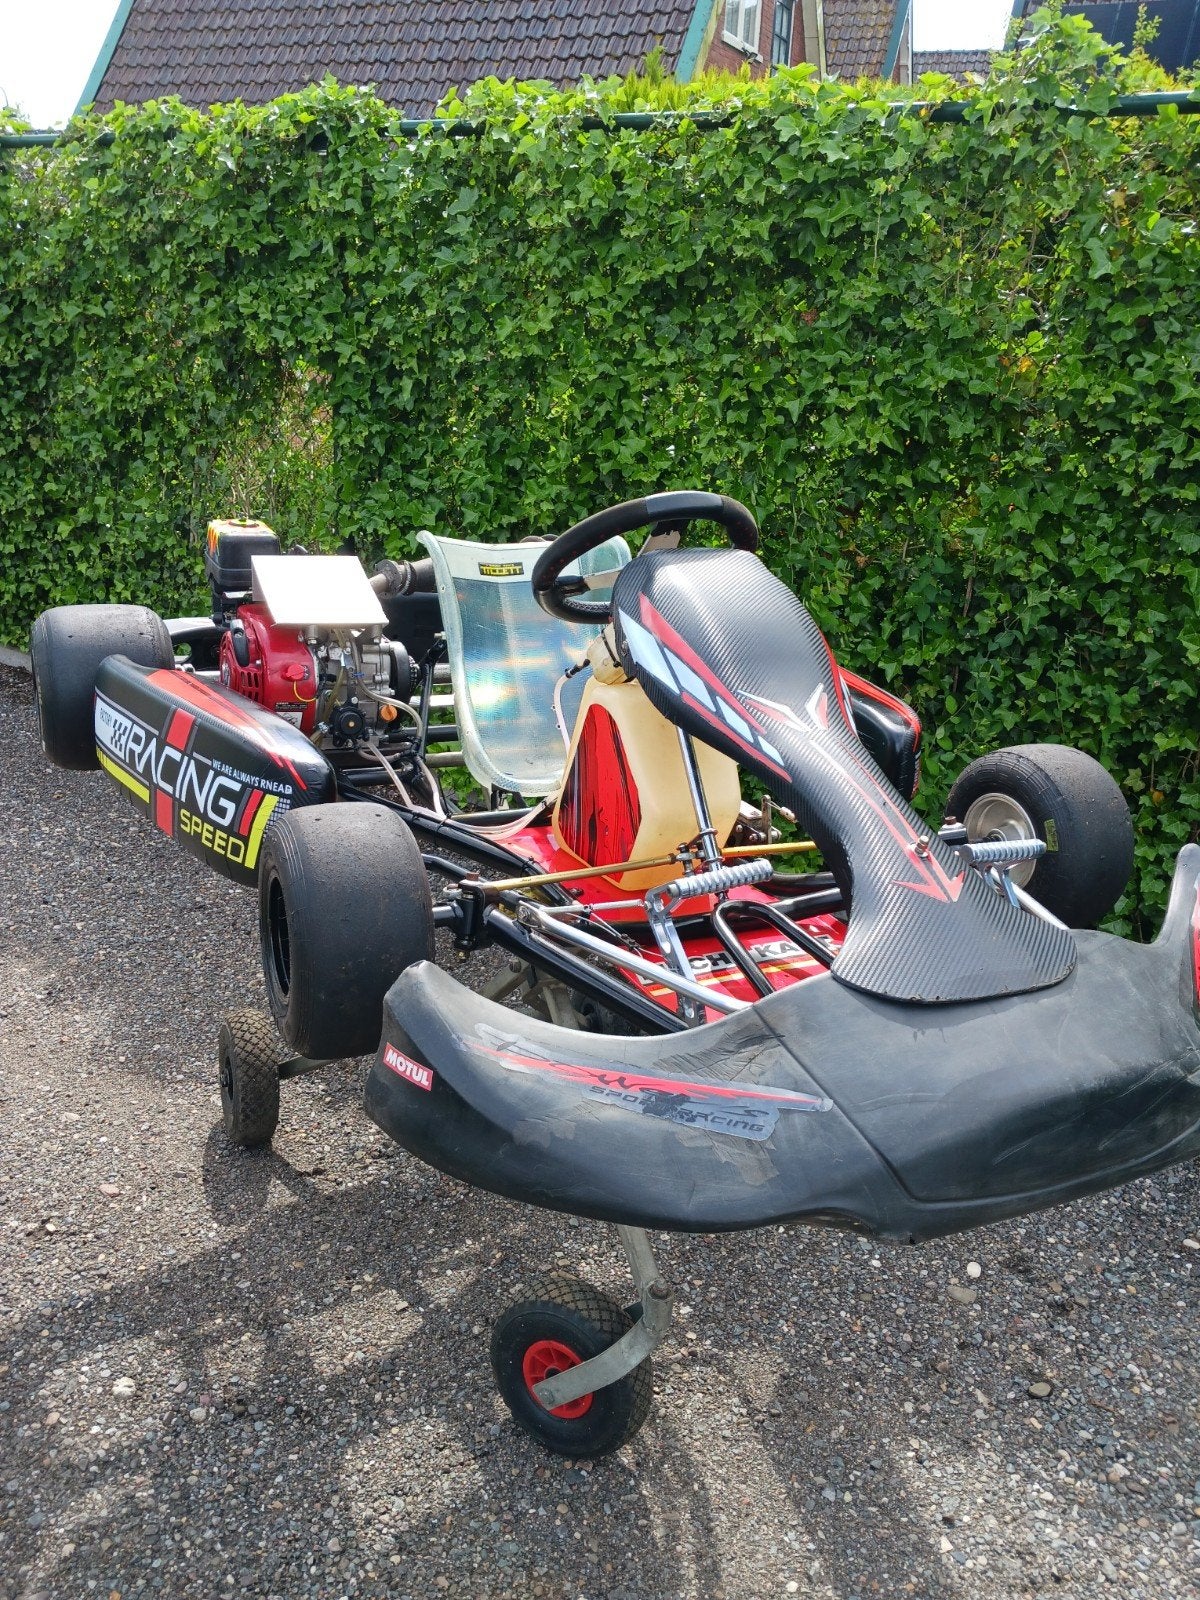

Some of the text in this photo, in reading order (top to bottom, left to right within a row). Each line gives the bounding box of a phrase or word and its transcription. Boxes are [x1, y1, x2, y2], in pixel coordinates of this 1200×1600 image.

[125, 722, 242, 827] RACING
[212, 758, 221, 771] WE
[221, 764, 233, 777] ARE
[232, 769, 260, 787] ALWAYS
[180, 808, 245, 865] SPEED
[385, 1048, 430, 1087] MOTUL
